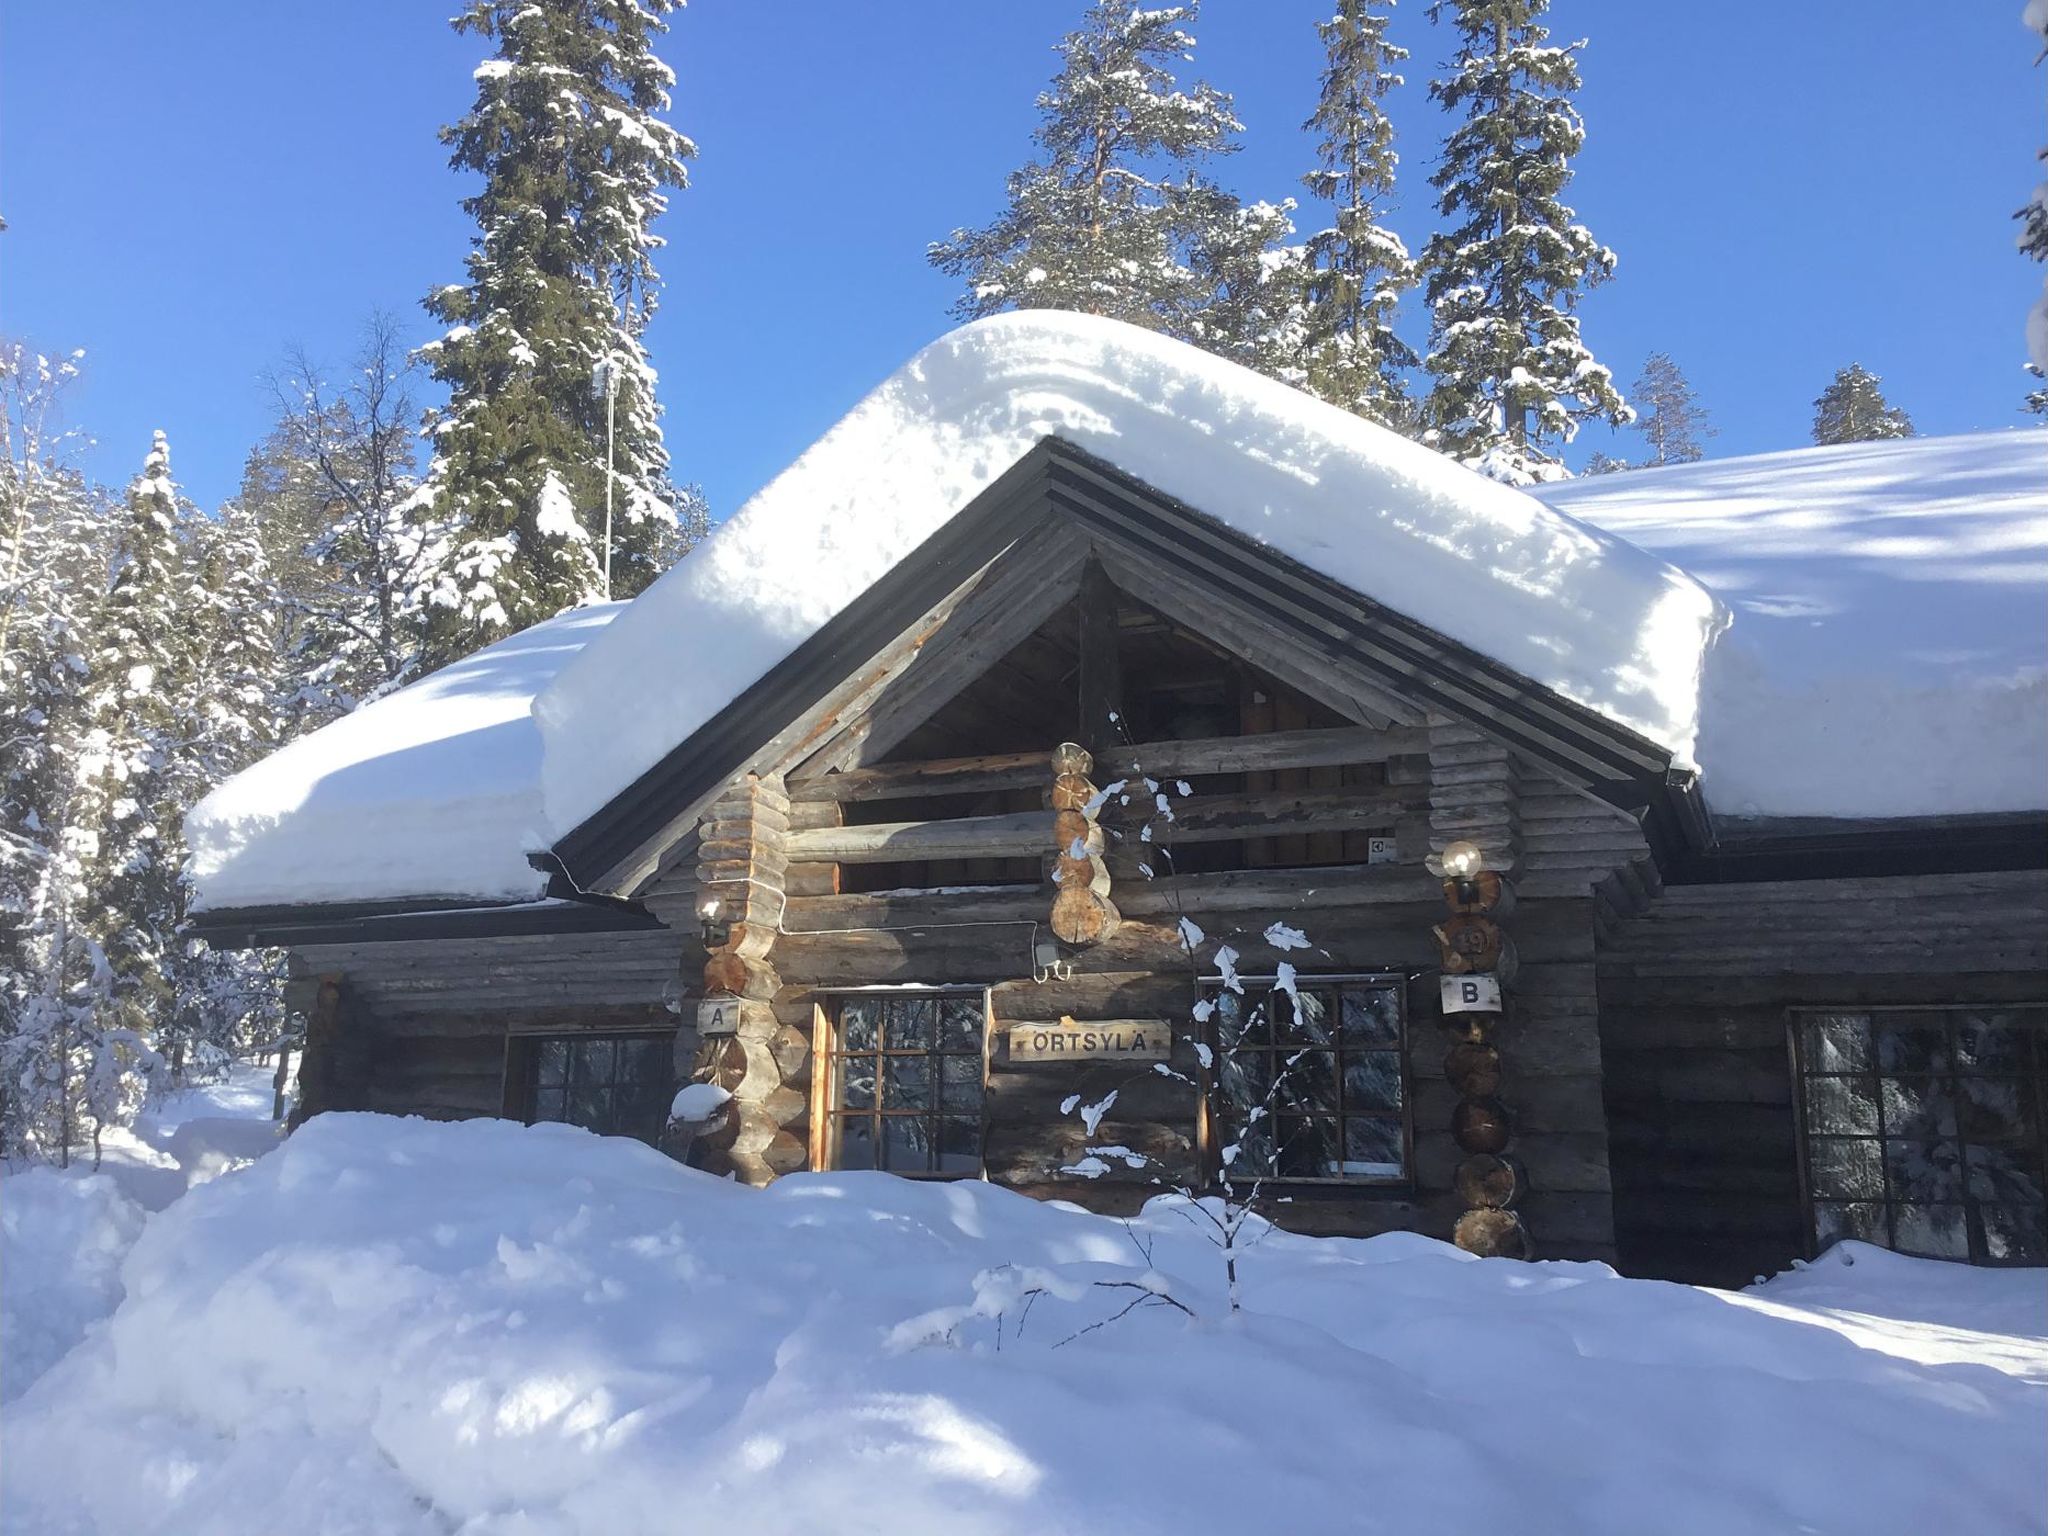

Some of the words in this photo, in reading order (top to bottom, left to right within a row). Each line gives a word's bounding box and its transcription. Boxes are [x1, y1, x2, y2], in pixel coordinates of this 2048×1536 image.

[1462, 982, 1479, 1003] B
[711, 1008, 723, 1025] A
[1033, 1029, 1147, 1052] ÖRTSYLÄ
